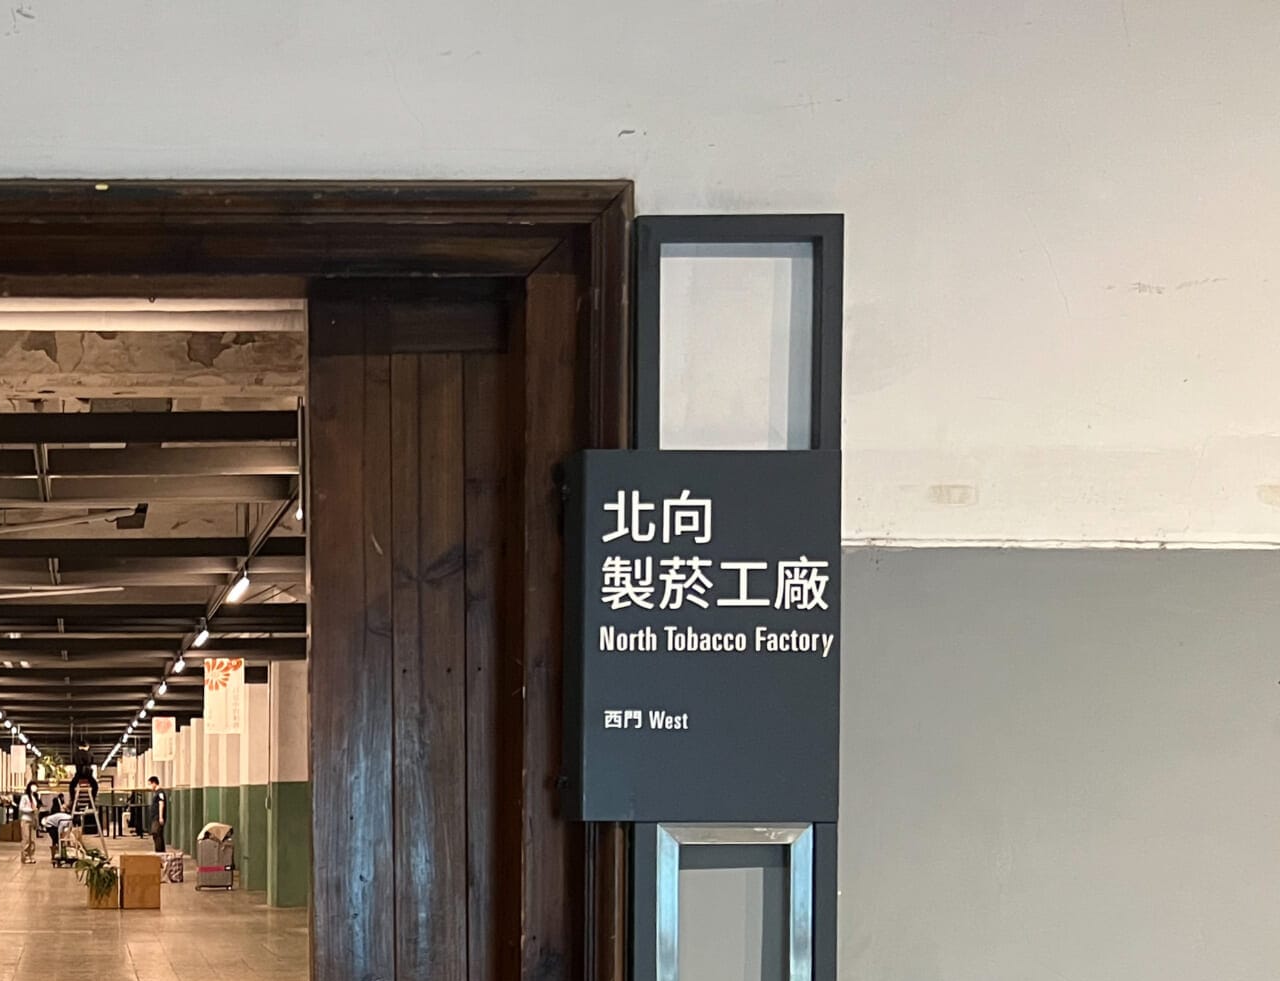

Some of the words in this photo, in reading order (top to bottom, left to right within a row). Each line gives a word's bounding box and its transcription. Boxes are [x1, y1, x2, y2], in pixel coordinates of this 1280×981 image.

[601, 489, 712, 544] 北向
[601, 555, 830, 611] 製菸工廠
[599, 625, 658, 652] North
[663, 625, 747, 652] Tobacco
[755, 626, 835, 658] Factory
[603, 709, 643, 729] 西門
[648, 710, 689, 730] West
